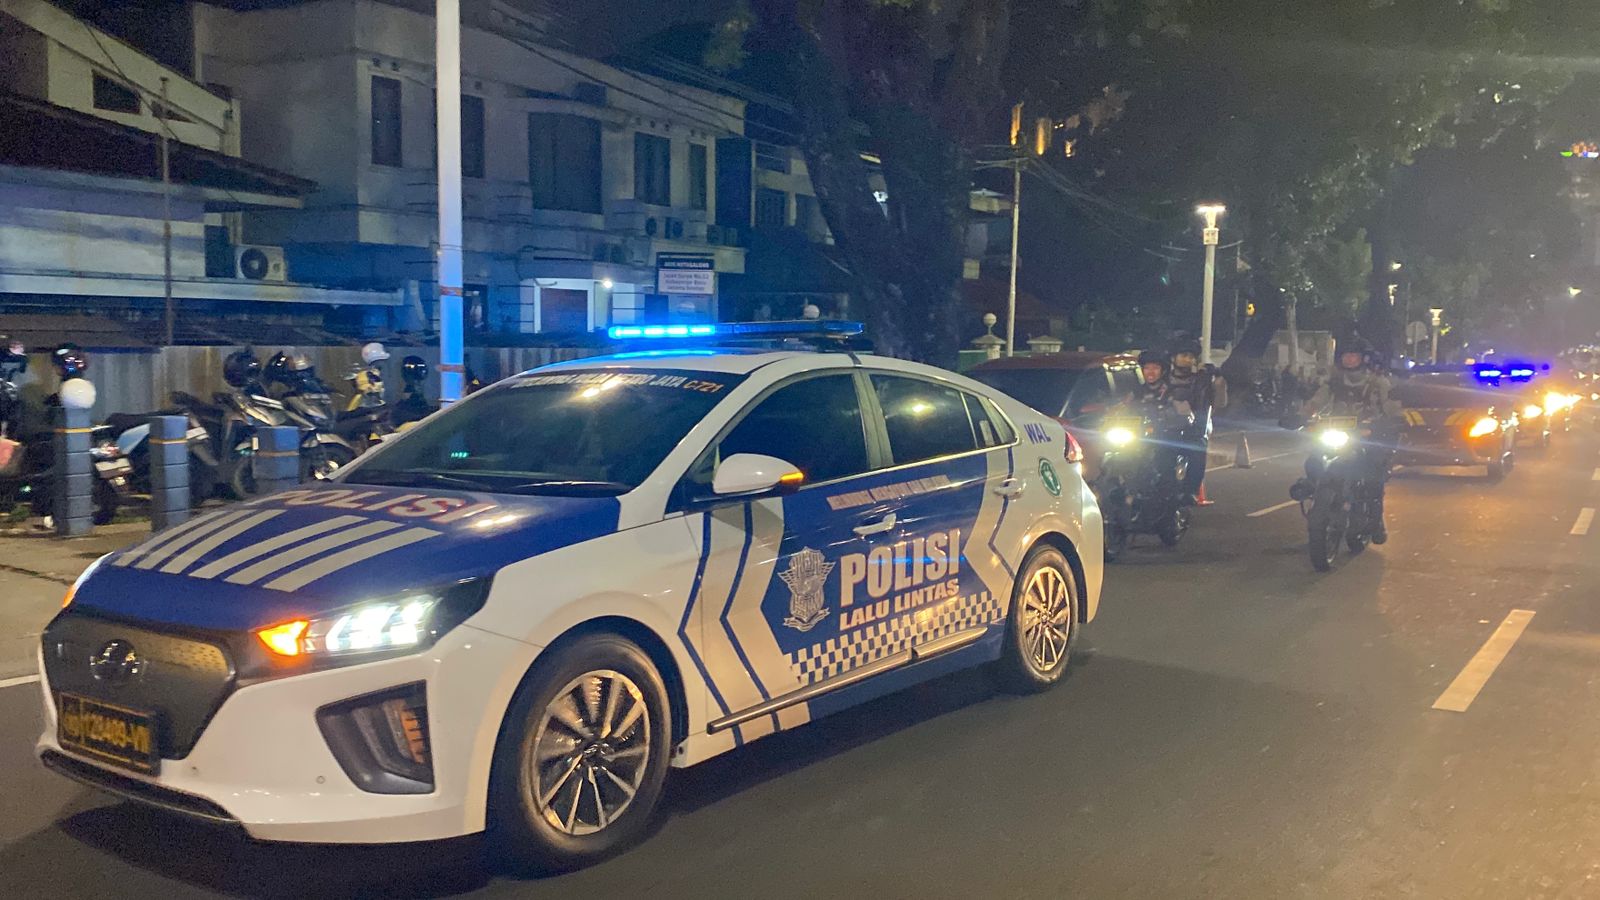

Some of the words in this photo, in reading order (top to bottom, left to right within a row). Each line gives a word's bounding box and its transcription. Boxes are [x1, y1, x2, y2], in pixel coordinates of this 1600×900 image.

[649, 376, 688, 388] JAYA
[1024, 423, 1052, 445] WAL
[243, 490, 498, 524] POLISI
[840, 528, 961, 608] POLISI
[839, 599, 890, 631] LALU
[894, 578, 960, 613] LINTAS
